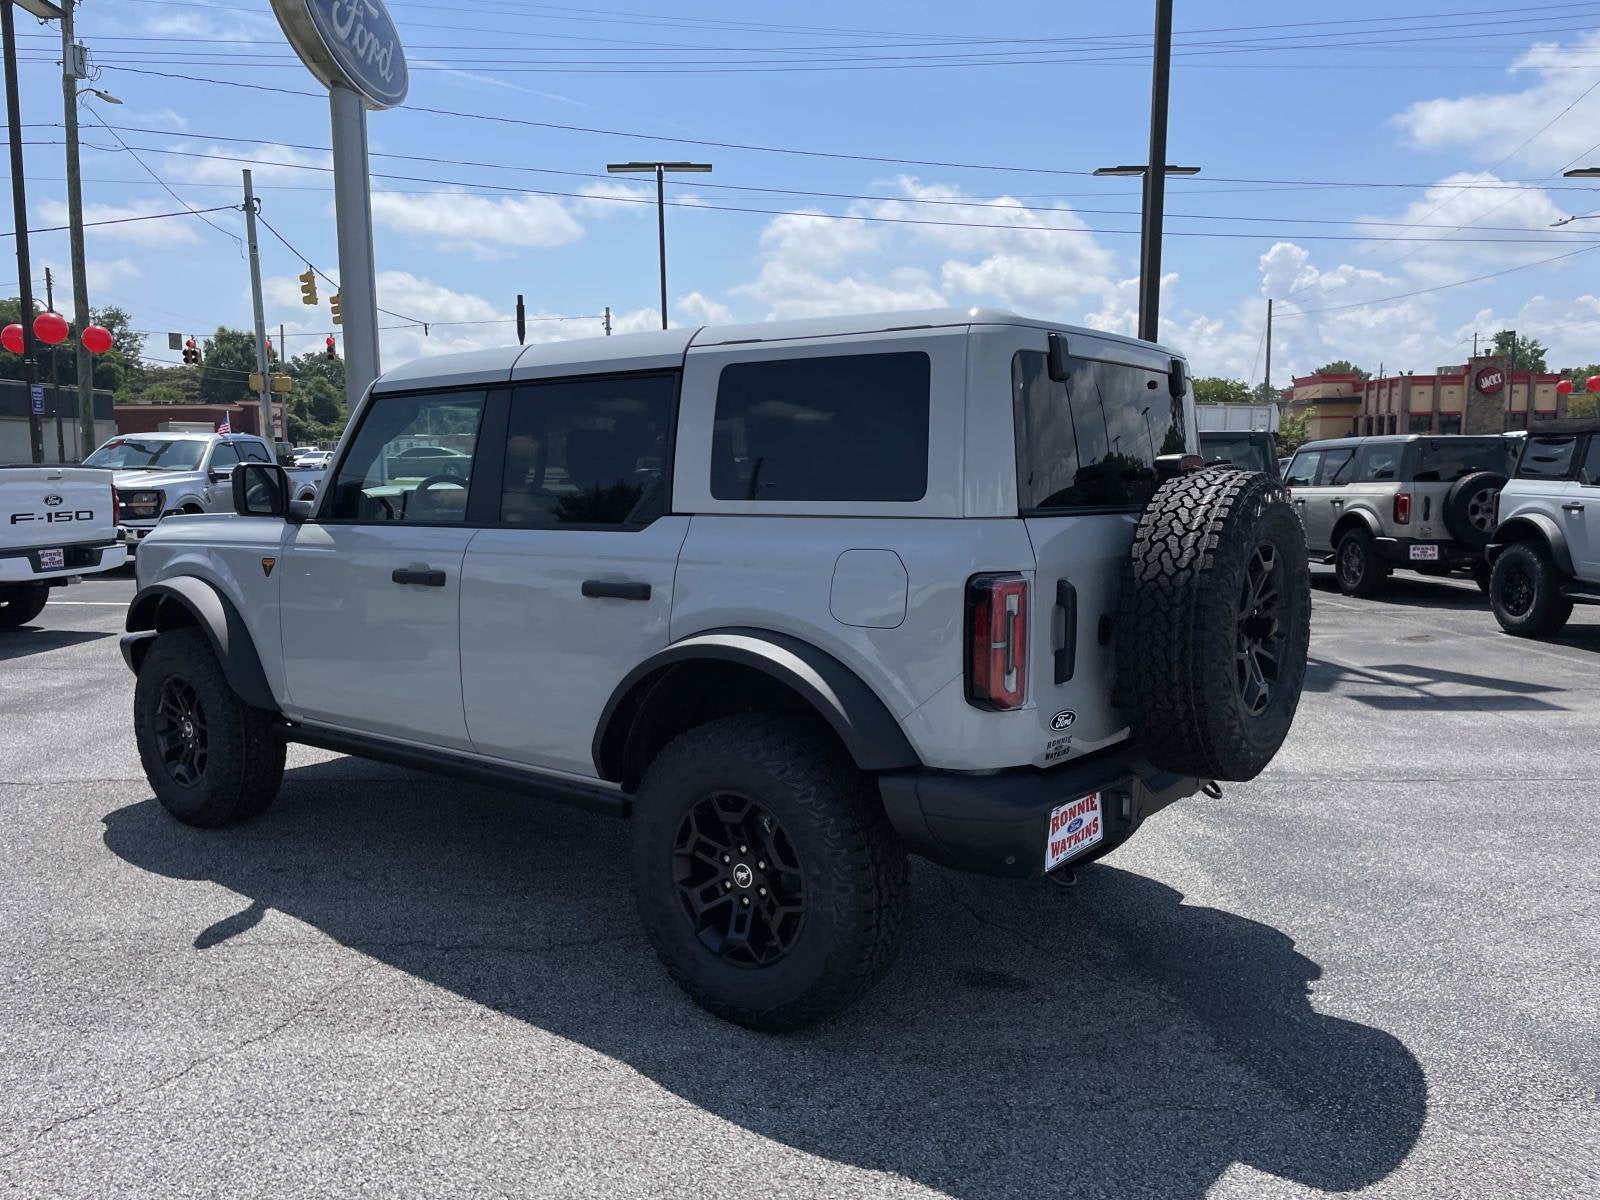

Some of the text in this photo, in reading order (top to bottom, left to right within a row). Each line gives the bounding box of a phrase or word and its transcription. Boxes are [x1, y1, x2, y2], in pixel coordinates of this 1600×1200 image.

[332, 0, 394, 82] Ford
[11, 510, 94, 525] F-150
[1052, 792, 1098, 836] RONNIE
[1051, 817, 1099, 859] WATKINS
